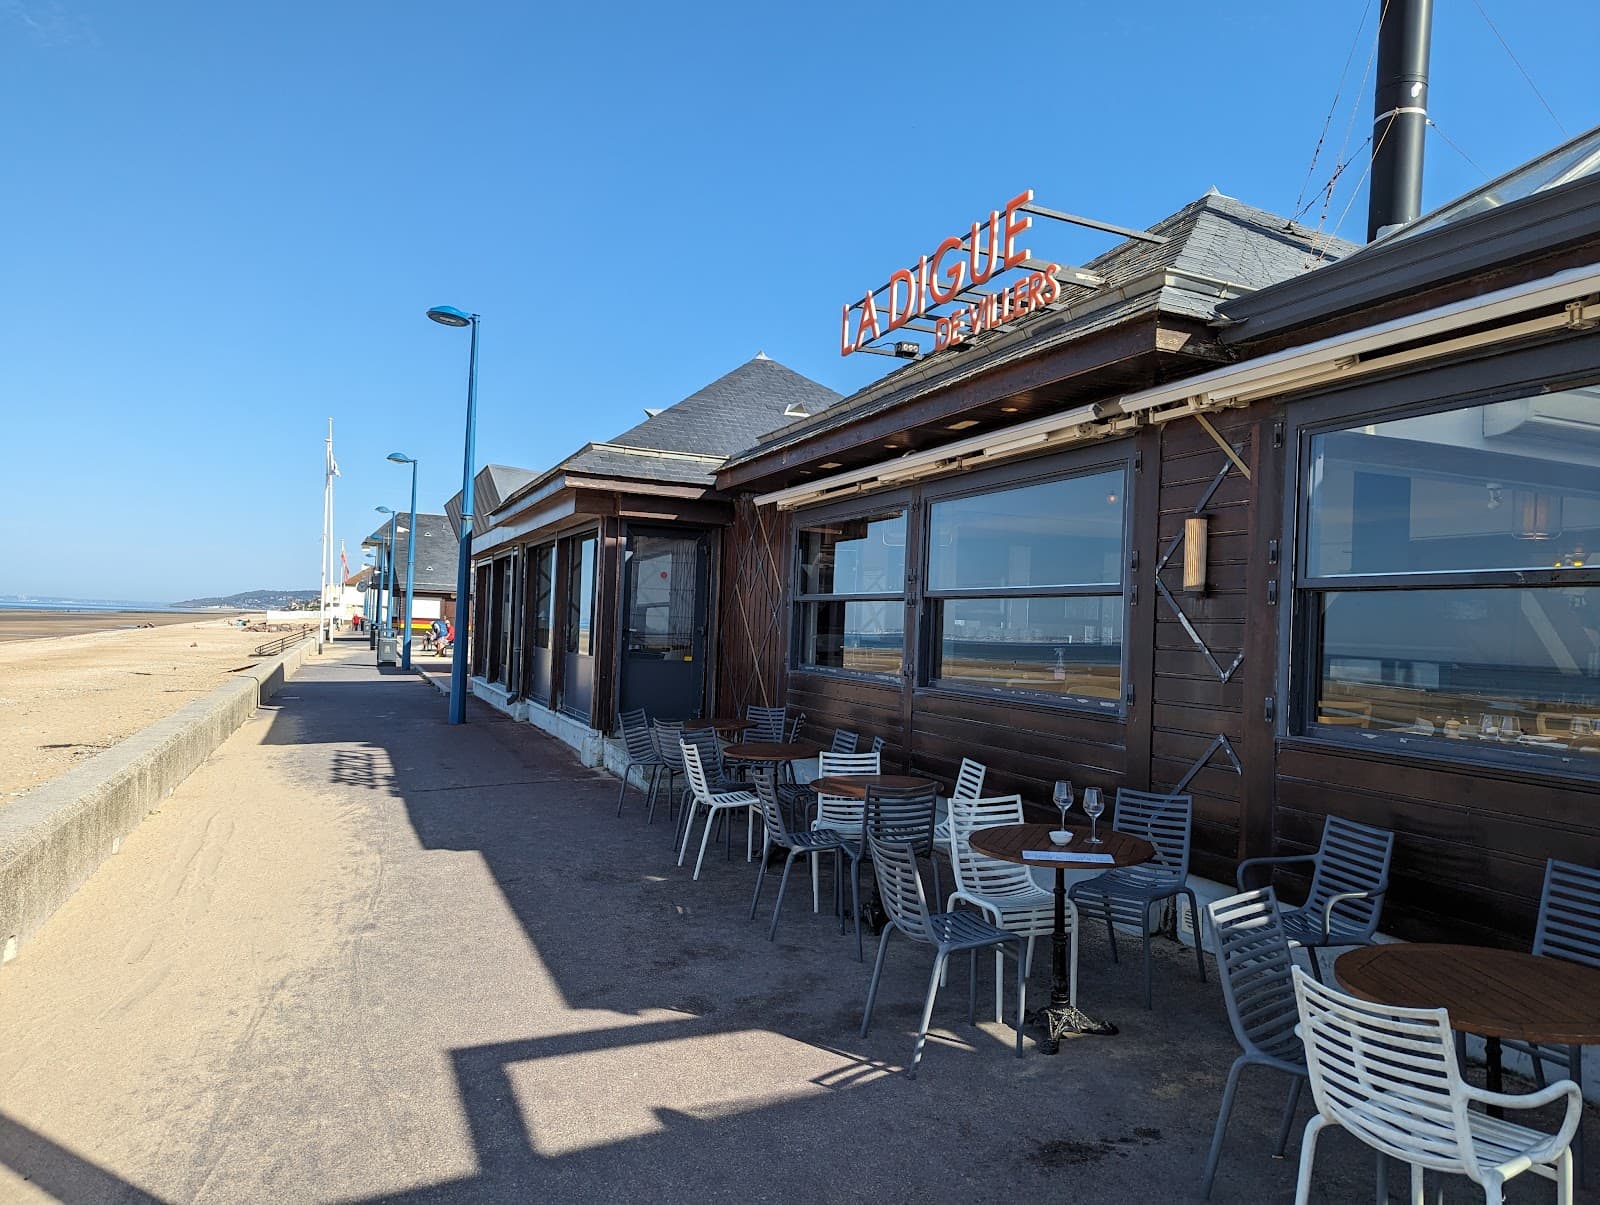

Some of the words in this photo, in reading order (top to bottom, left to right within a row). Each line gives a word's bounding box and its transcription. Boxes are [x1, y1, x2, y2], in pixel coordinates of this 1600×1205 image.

[841, 290, 880, 357] LA
[888, 189, 1034, 331] DIGUE
[935, 308, 965, 352] DE
[969, 263, 1061, 335] VILLERS
